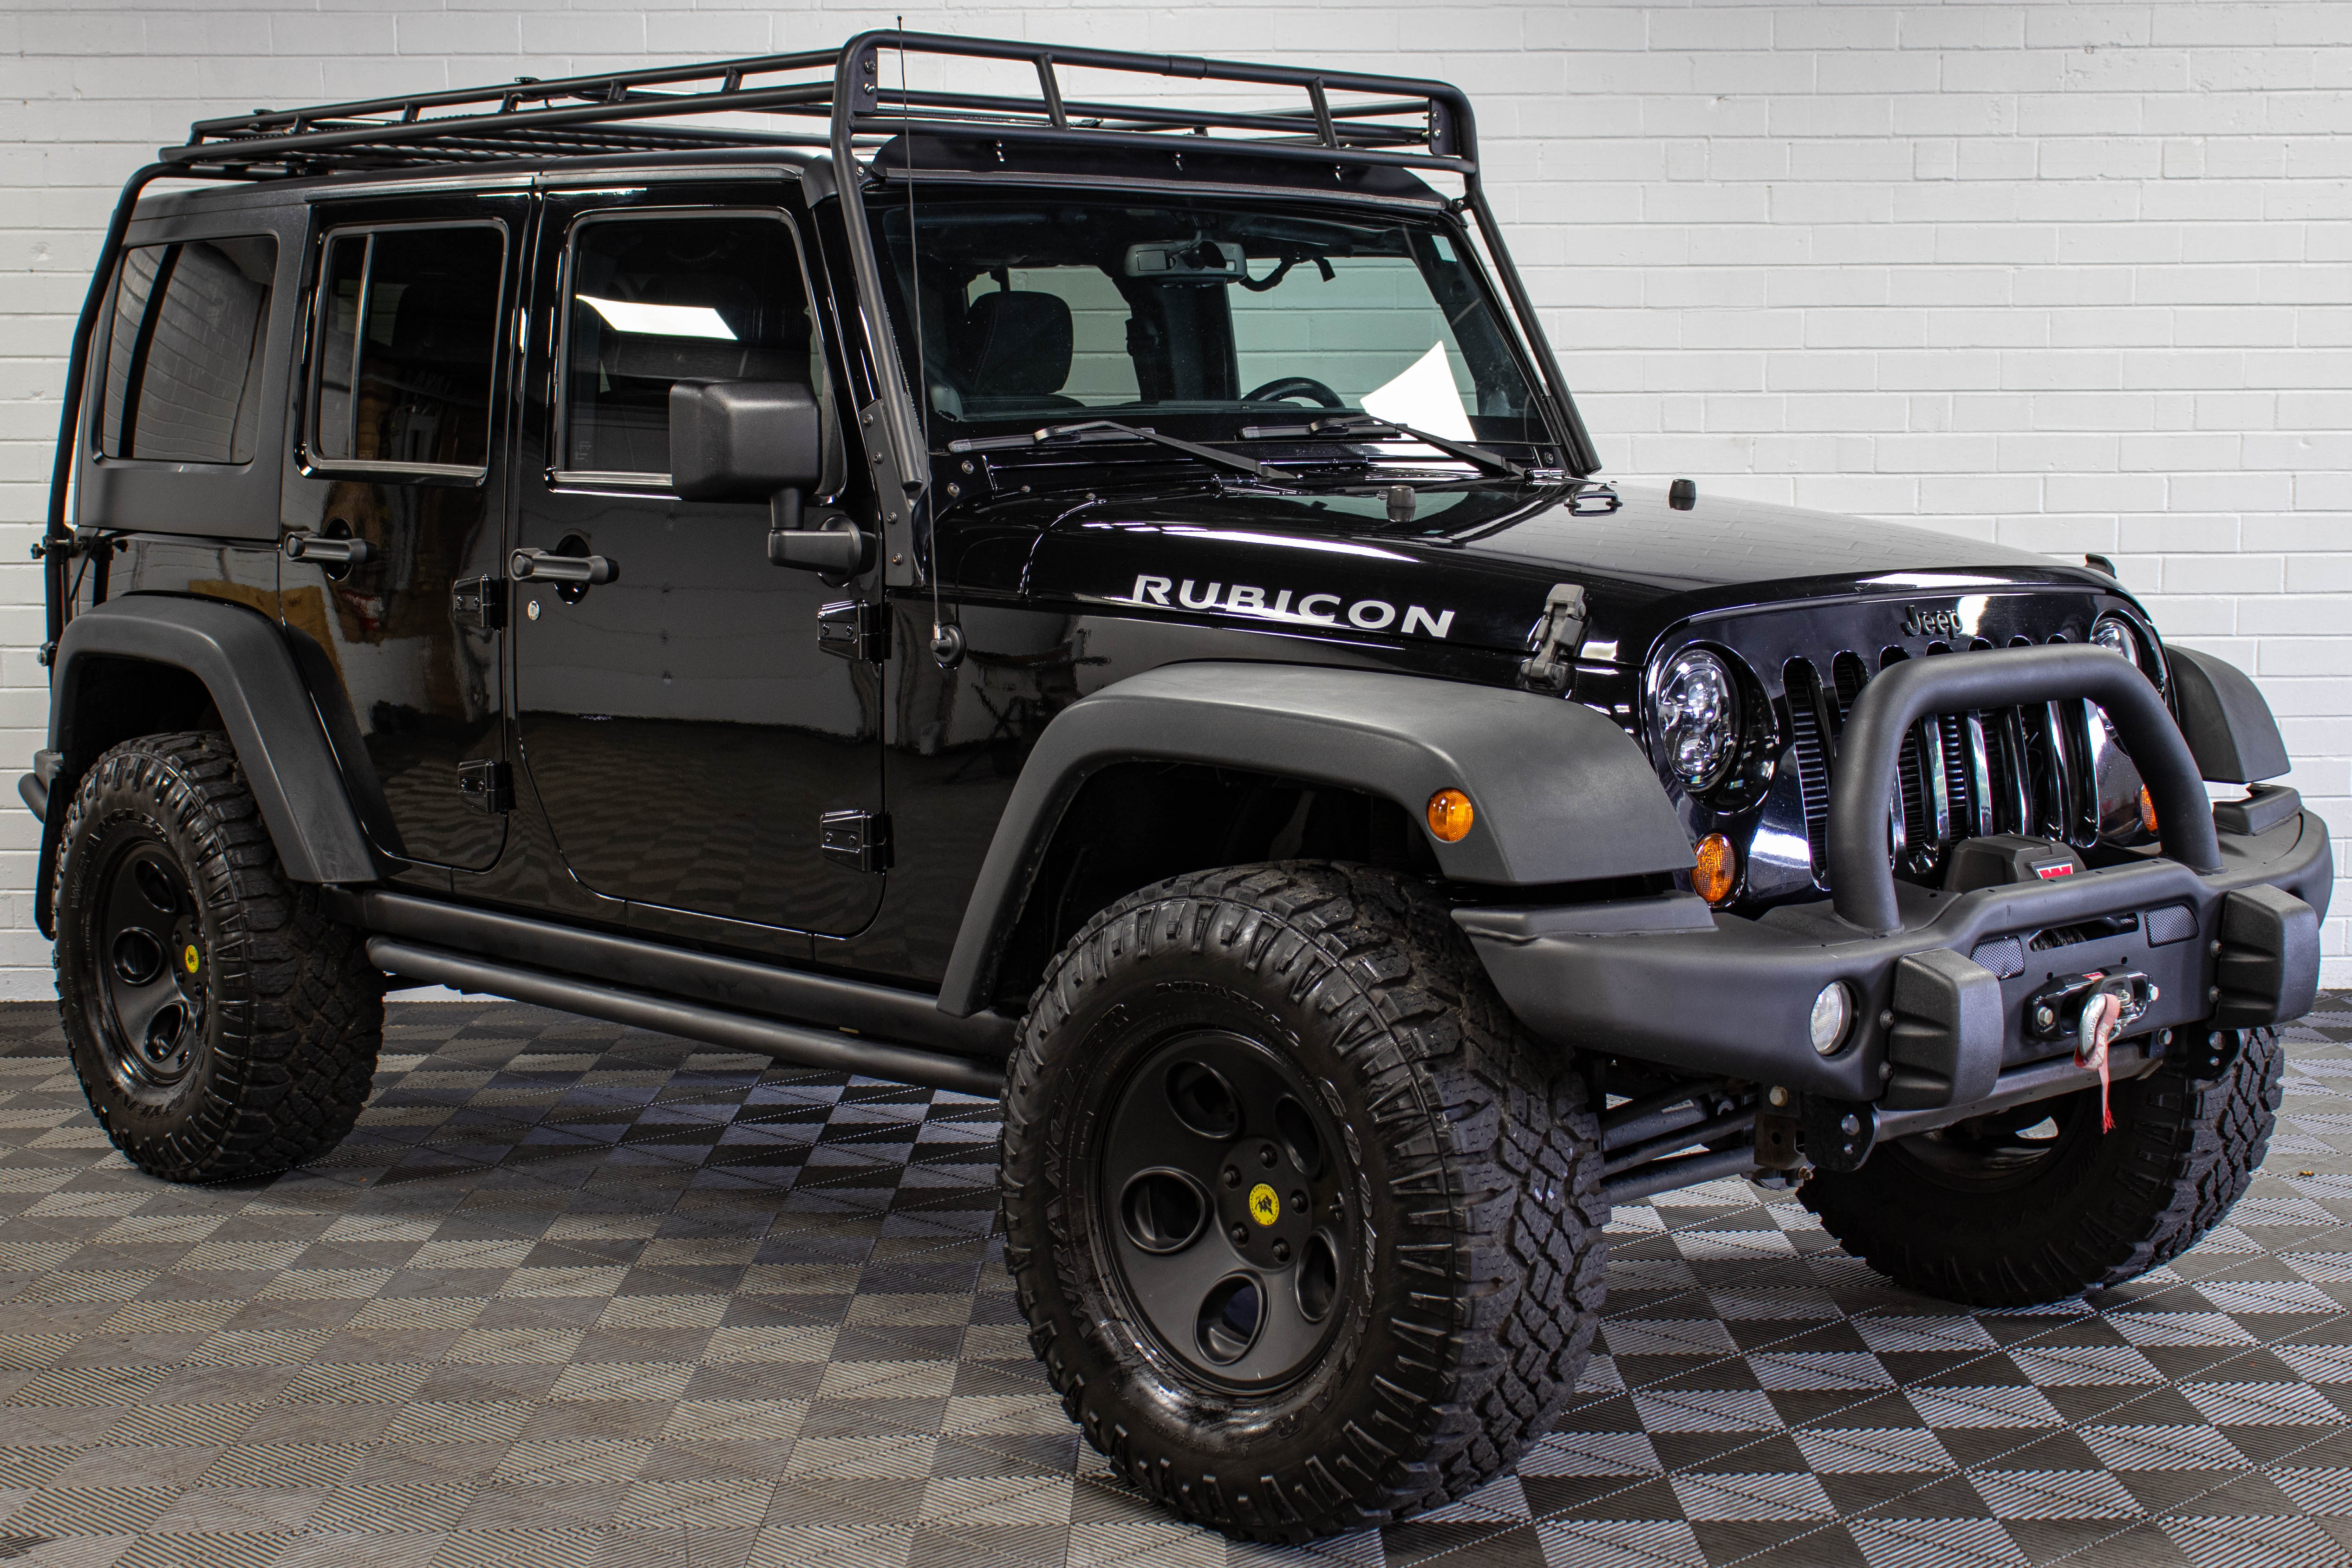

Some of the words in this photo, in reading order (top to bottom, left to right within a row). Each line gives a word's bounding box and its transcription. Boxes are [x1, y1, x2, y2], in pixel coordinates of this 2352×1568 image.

[1132, 573, 1455, 638] RUBICON
[1902, 605, 1962, 639] Jeep
[1155, 980, 1301, 1047] DURATRAC
[1044, 1003, 1129, 1340] WRANGLER
[1250, 1193, 1261, 1222] AMERICAN
[1253, 1185, 1277, 1199] EXPEDITION
[1266, 1200, 1279, 1224] VEHICLES
